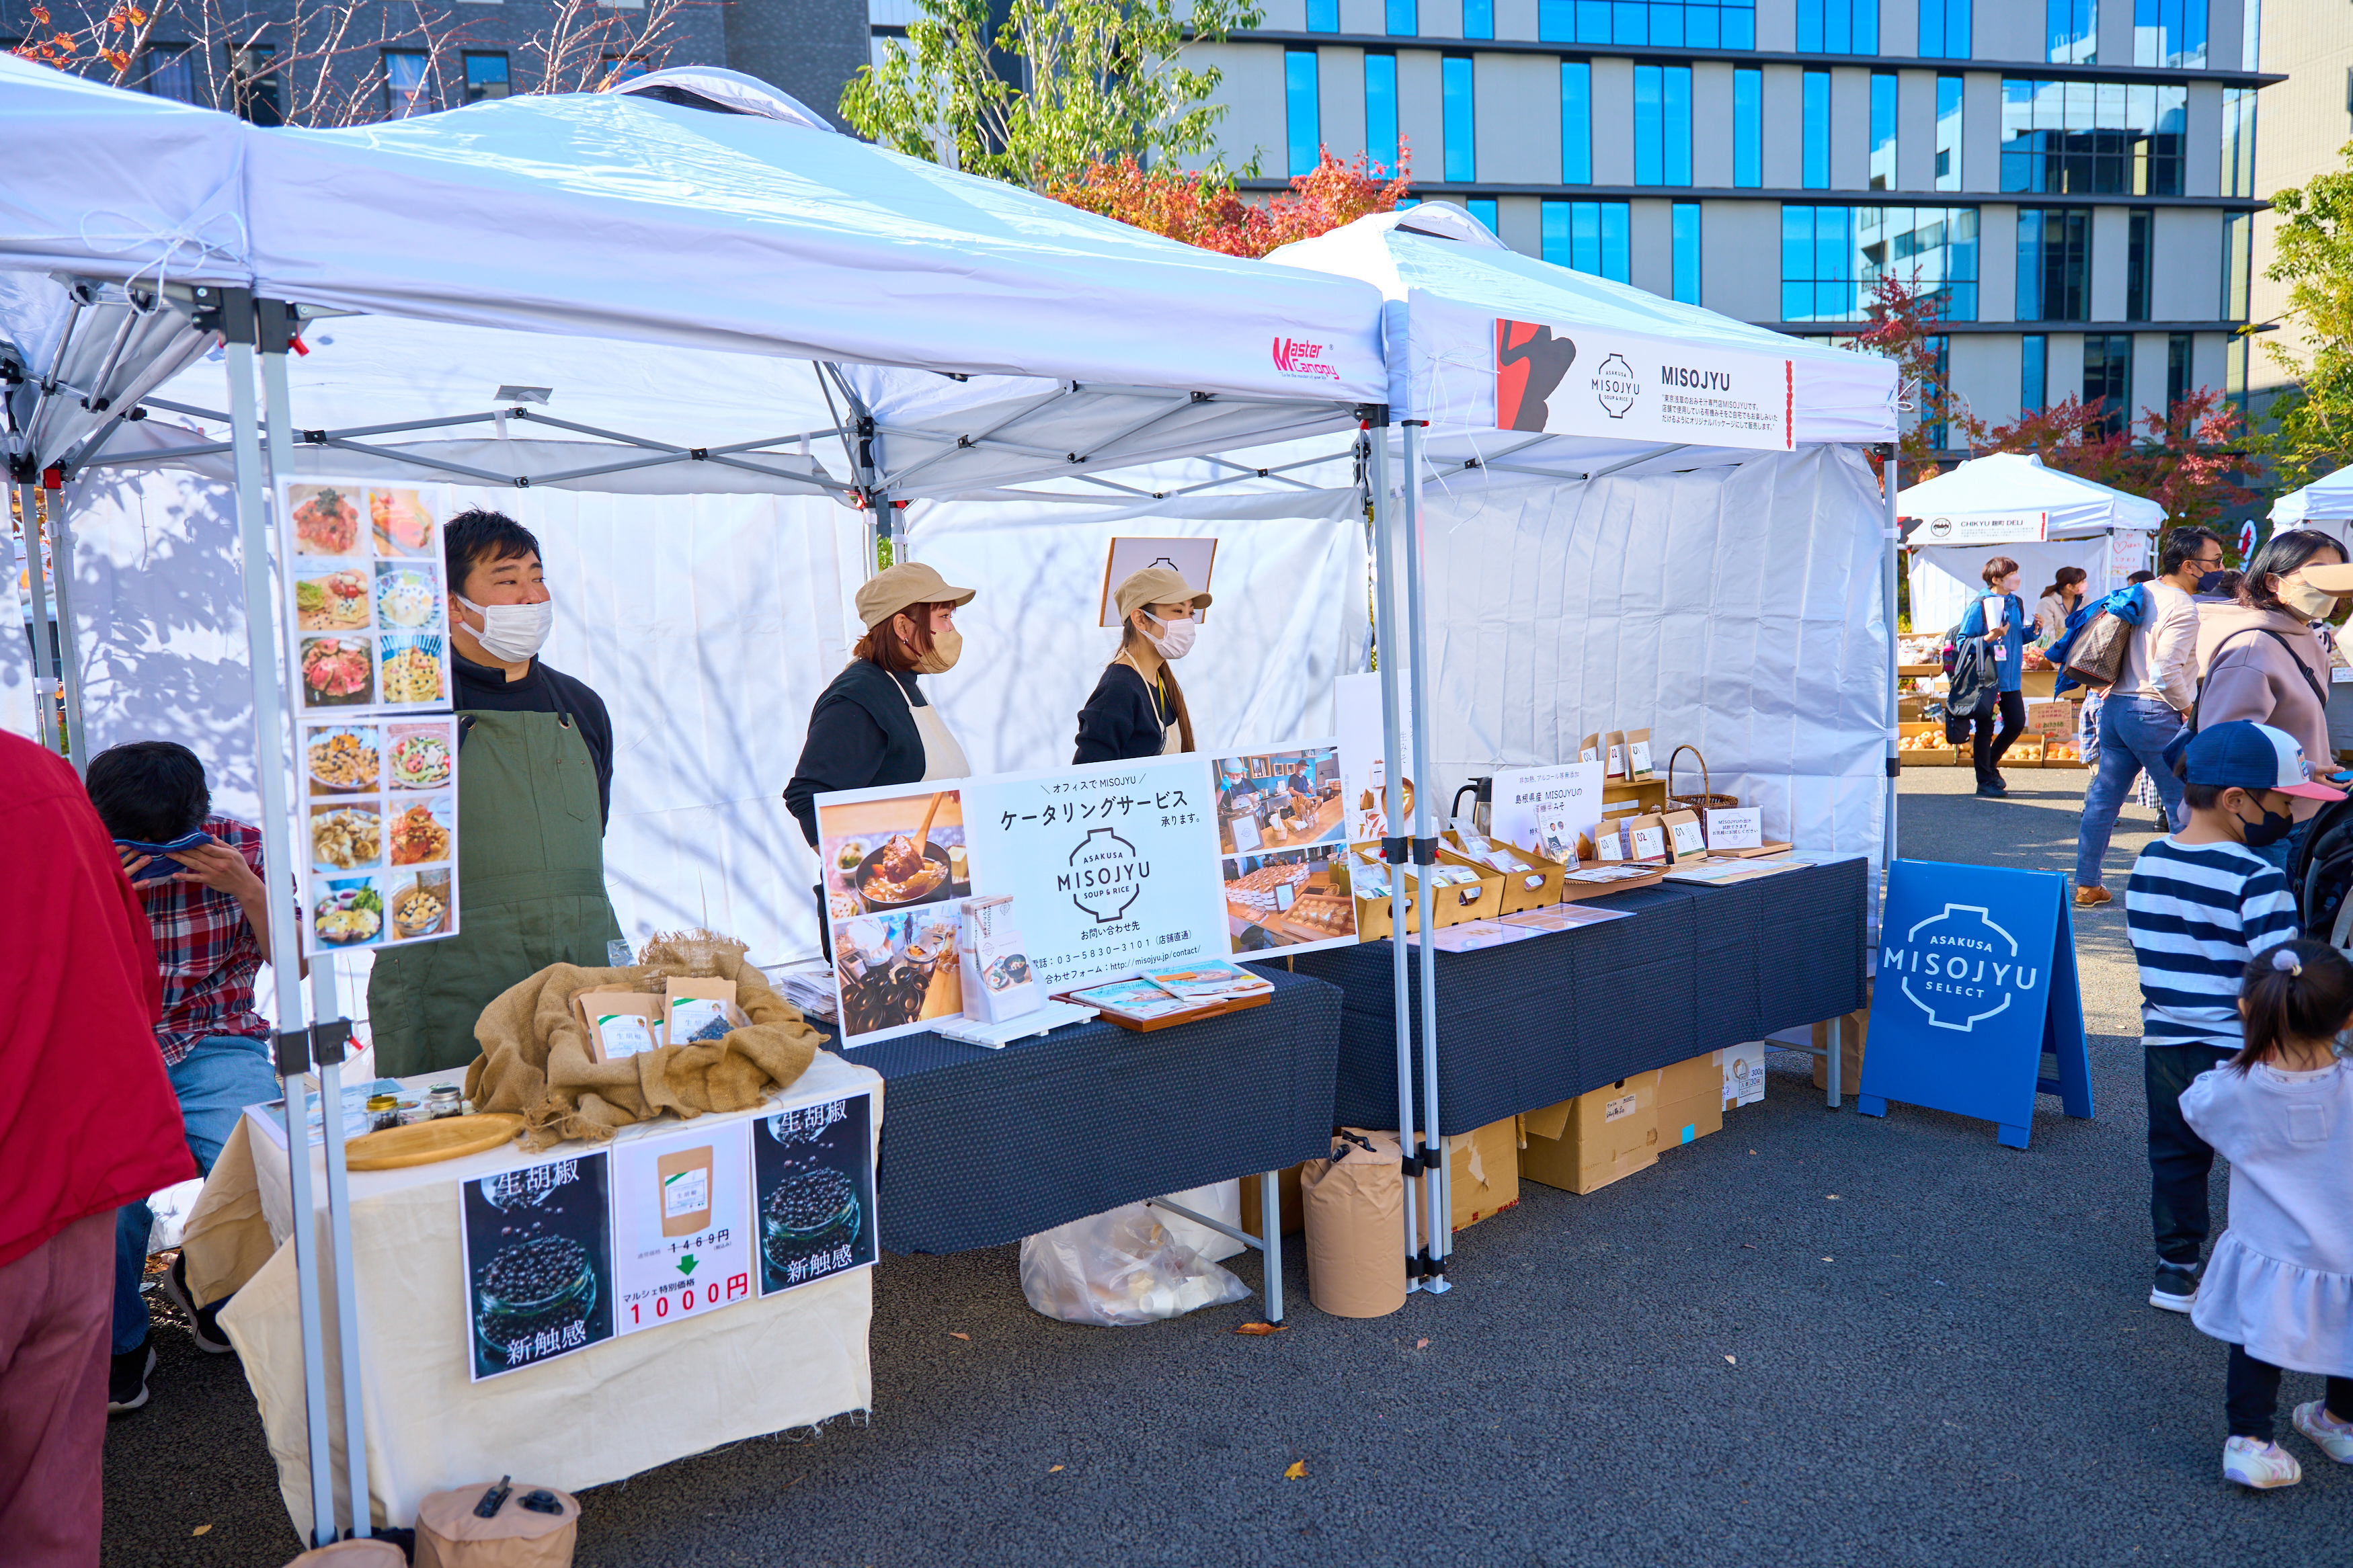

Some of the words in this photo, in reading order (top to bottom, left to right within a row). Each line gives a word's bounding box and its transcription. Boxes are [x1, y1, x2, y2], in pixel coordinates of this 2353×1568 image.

[1273, 337, 1322, 372] Master
[1292, 358, 1340, 380] Canopy
[1662, 365, 1730, 391] MISOJYU
[1591, 378, 1640, 395] MISOJYU
[1583, 752, 1591, 762] 03
[1611, 748, 1618, 758] 02
[1053, 780, 1097, 794] オフィスで
[1099, 776, 1136, 788] MISOJYU
[1515, 792, 1542, 804] 島根県産
[1545, 788, 1583, 800] MISOJYUの
[1001, 790, 1188, 831] ケータリングサービス
[1161, 812, 1200, 827] 承ります。
[1636, 832, 1647, 842] 02
[1675, 827, 1685, 837] 01
[1601, 839, 1609, 850] 03
[1083, 852, 1123, 864] ASAKUSA
[1057, 861, 1150, 892] MISOJYU
[1084, 889, 1104, 899] SOUP
[1113, 886, 1129, 895] RICE
[1080, 921, 1140, 941] お問い合わせ先
[1929, 935, 1993, 953] ASAKUSA
[1883, 946, 2037, 990] MISOJYU
[1925, 981, 1985, 999] SELECT
[781, 1100, 848, 1134] 生胡椒
[497, 1159, 580, 1198] 生胡椒
[670, 1229, 729, 1253] 1469円
[787, 1243, 852, 1283] 新触感
[623, 1278, 695, 1303] マルシェ特別価格
[631, 1272, 748, 1325] 1000円
[506, 1319, 587, 1365] 新触感
